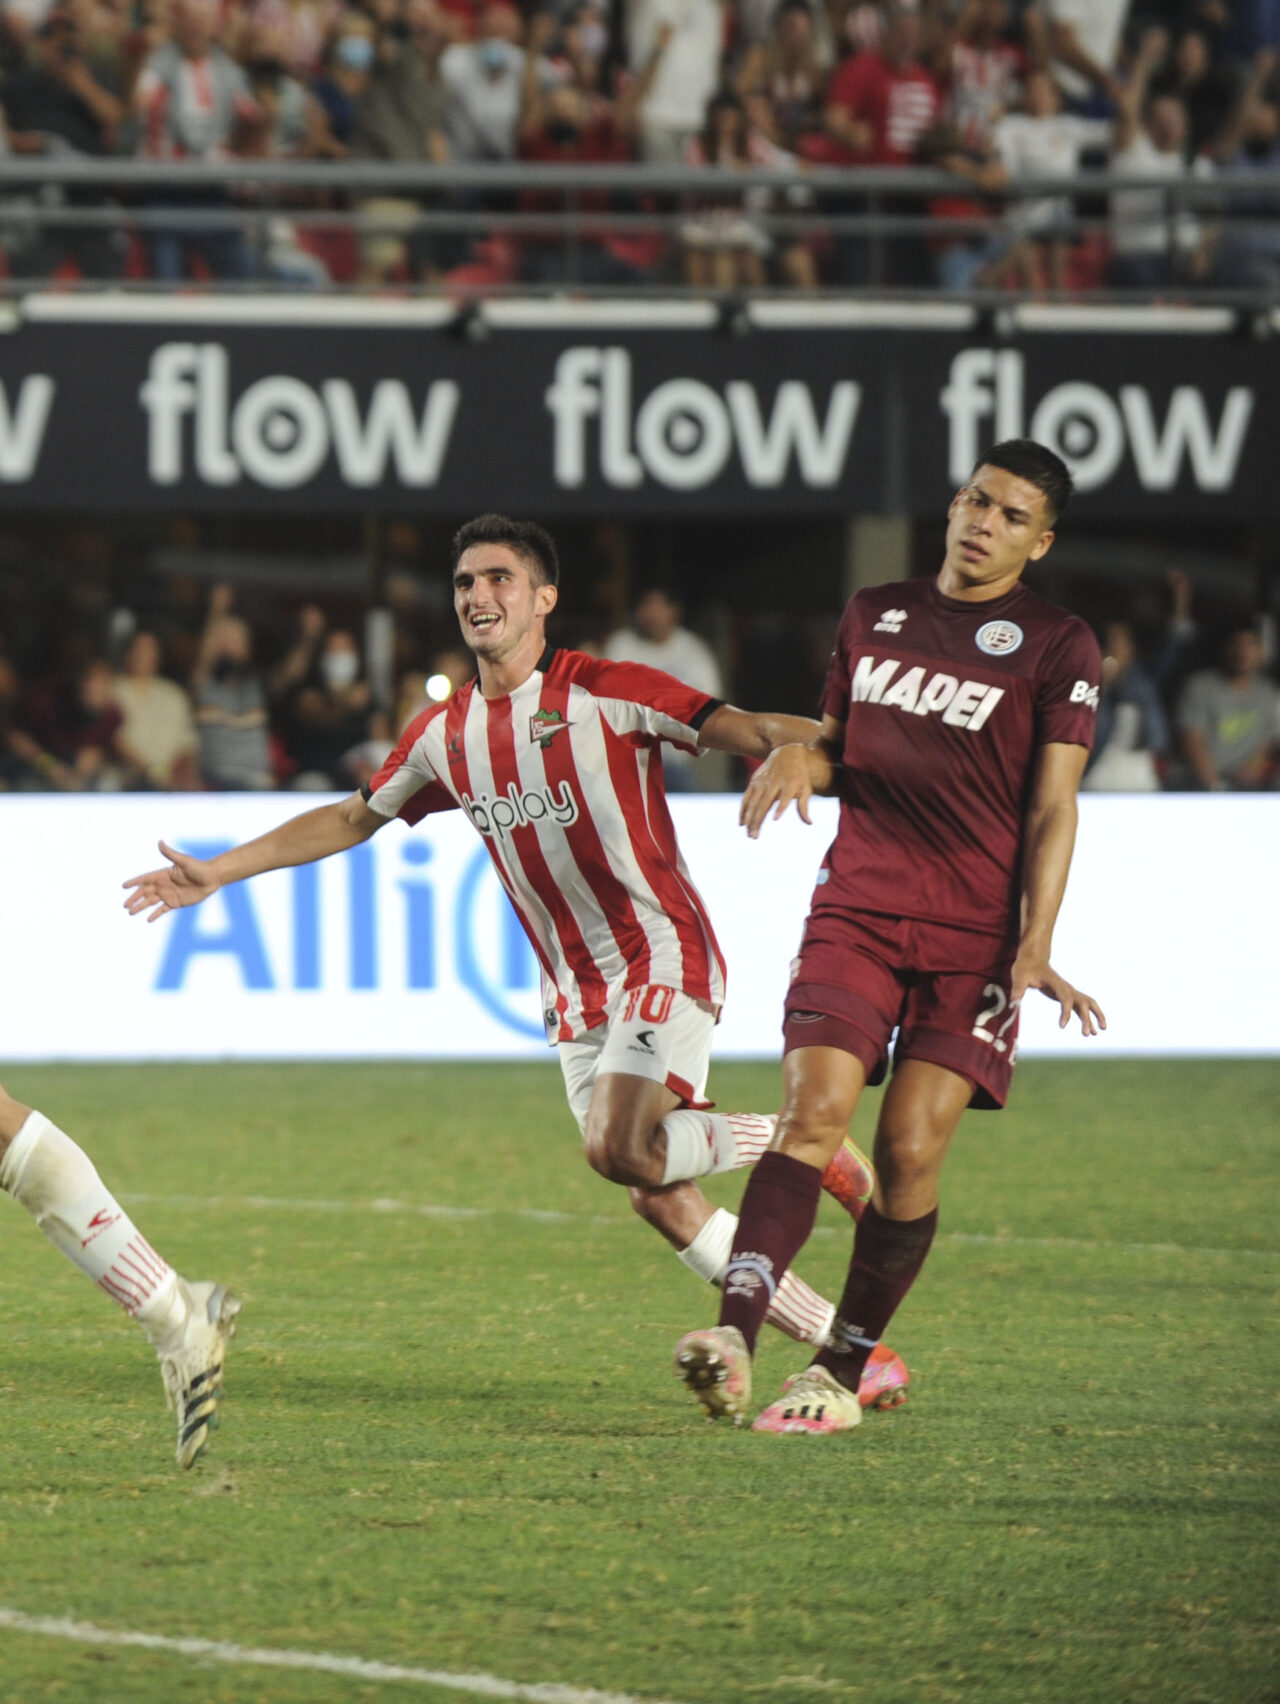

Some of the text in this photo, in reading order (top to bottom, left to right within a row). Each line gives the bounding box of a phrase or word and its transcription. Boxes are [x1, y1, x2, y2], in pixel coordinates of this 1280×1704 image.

[140, 342, 459, 488] flow
[546, 347, 860, 489] flow
[939, 348, 1254, 493] flow
[851, 656, 1006, 732] MAPEI
[623, 983, 676, 1025] 10
